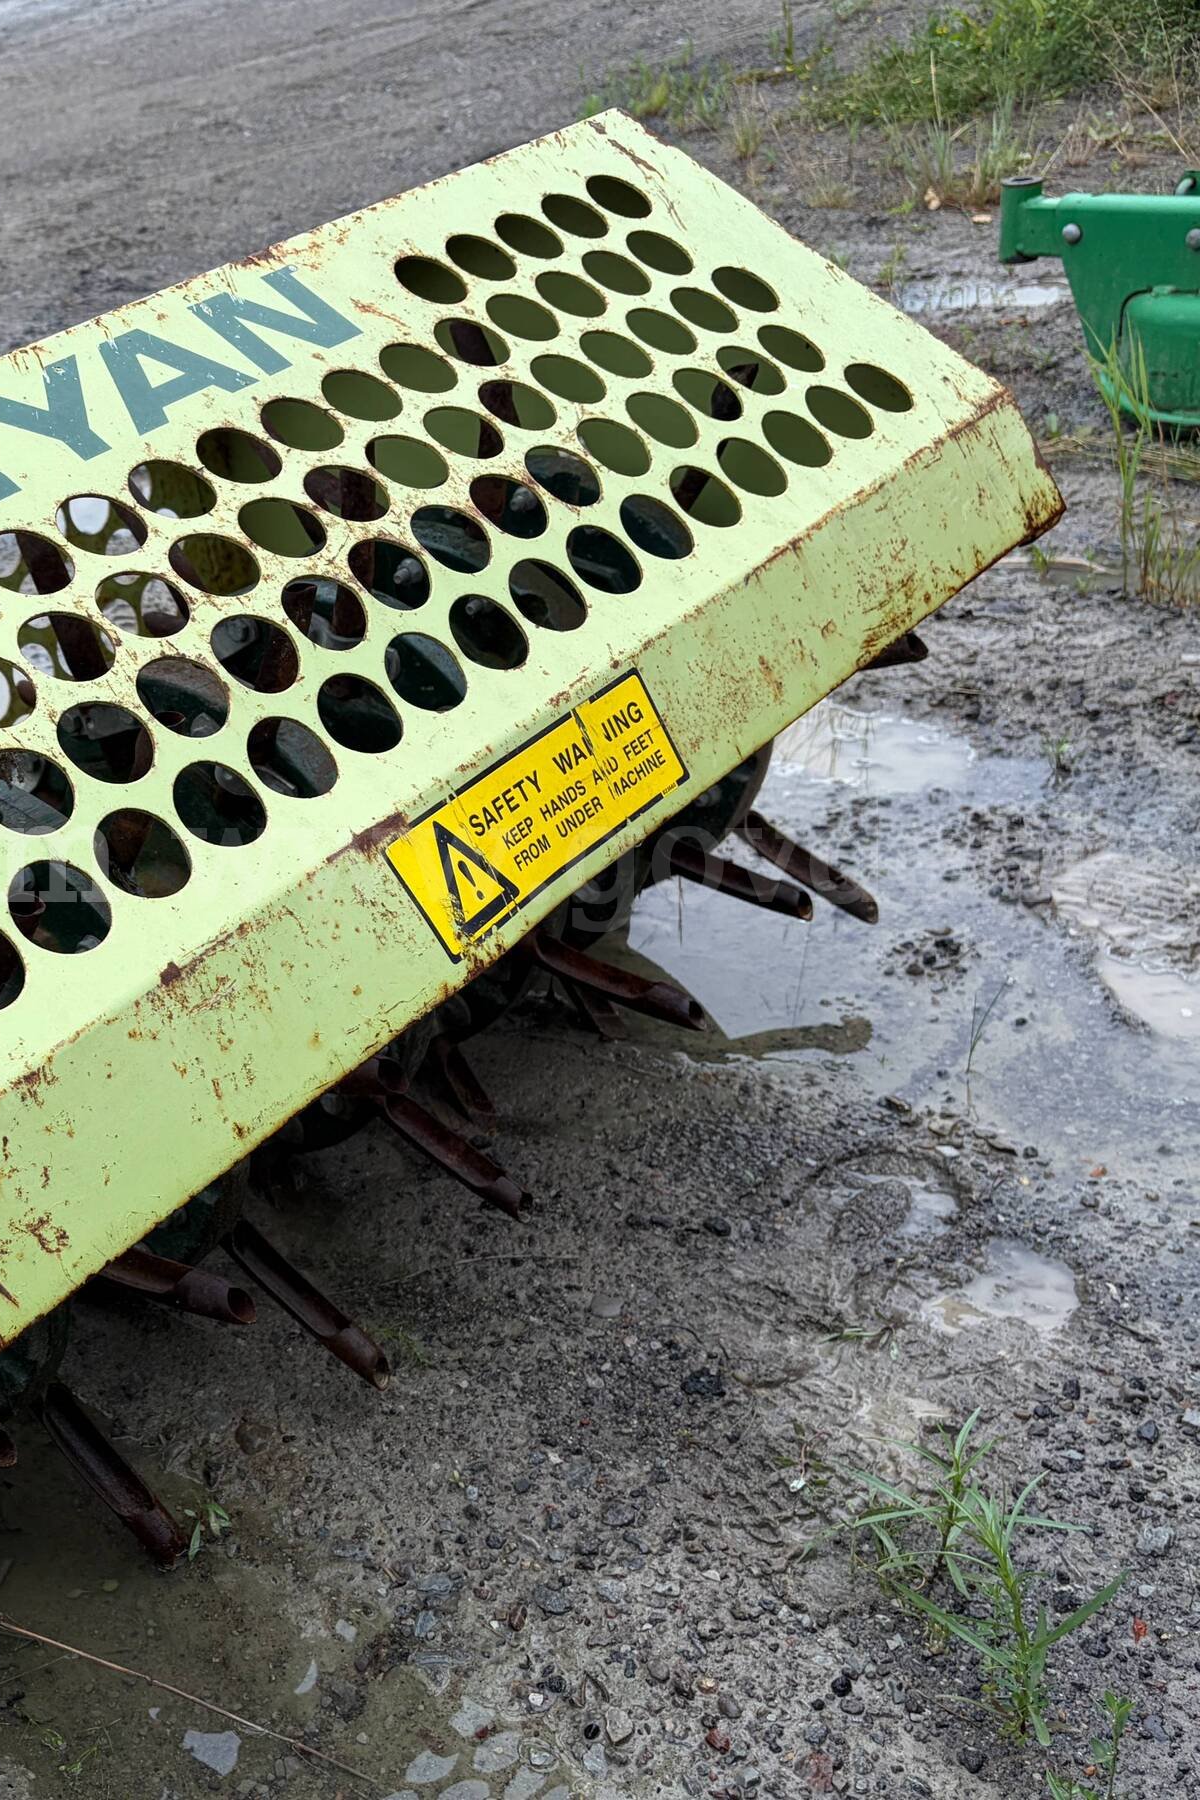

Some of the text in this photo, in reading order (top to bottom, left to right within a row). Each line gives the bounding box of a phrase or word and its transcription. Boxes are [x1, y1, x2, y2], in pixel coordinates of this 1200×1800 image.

[469, 770, 542, 836] SAFETY
[502, 818, 534, 850] KEEP
[540, 780, 587, 821] HANDS
[623, 730, 654, 761] FEET
[513, 749, 667, 872] FROM UNDER MACHINE
